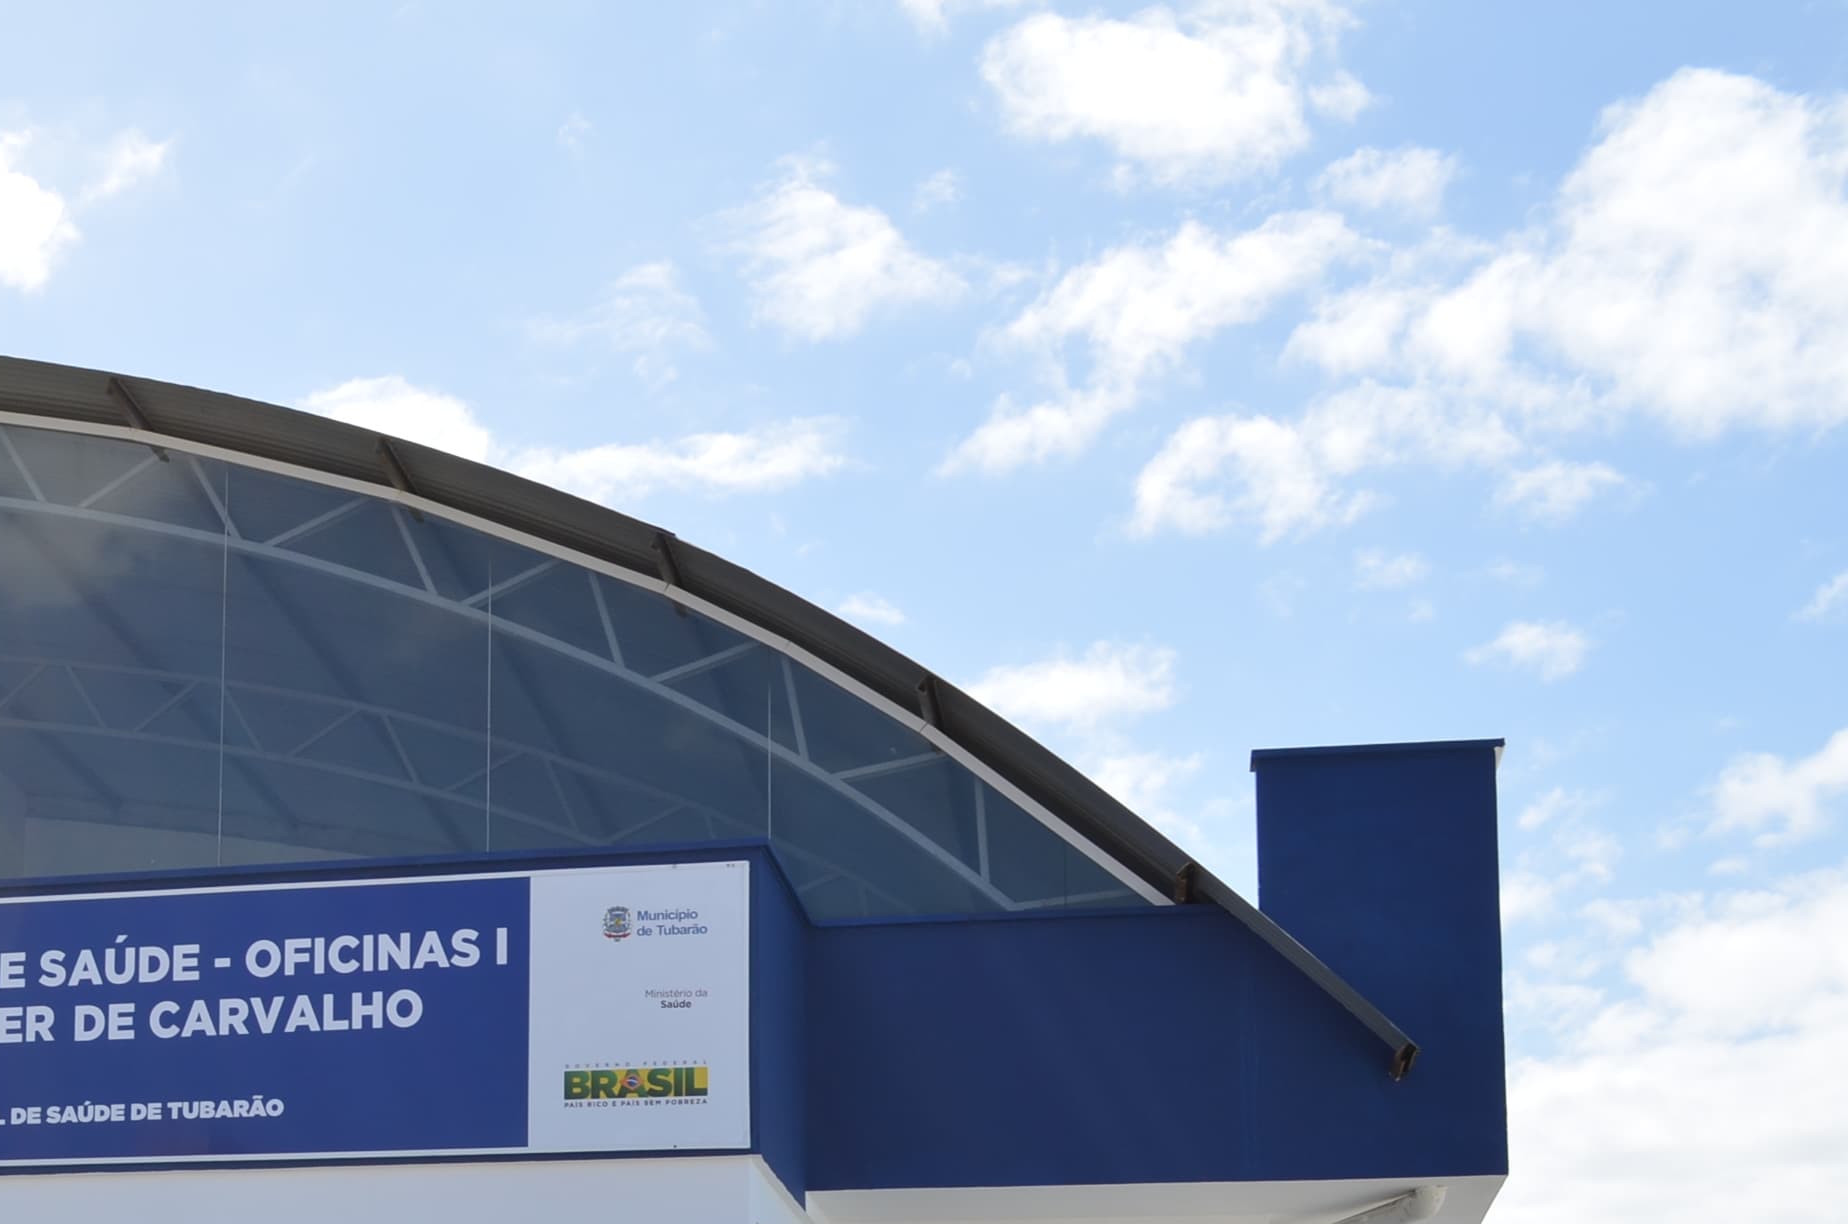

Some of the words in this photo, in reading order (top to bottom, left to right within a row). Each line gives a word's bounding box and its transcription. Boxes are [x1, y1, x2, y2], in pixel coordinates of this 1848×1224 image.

[636, 909, 699, 923] Município
[636, 926, 653, 937] de
[656, 924, 708, 937] Tubarão
[38, 934, 200, 987] SAÚDE
[214, 956, 232, 968] -
[245, 928, 481, 978] OFICINAS
[496, 927, 508, 965] I
[660, 999, 692, 1009] Saúde
[695, 988, 708, 998] da
[74, 1003, 135, 1042] DE
[149, 989, 424, 1039] CARVALHO
[564, 1067, 708, 1100] BRASIL
[10, 1107, 41, 1126] DE
[46, 1100, 125, 1124] SAÚDE
[130, 1101, 162, 1121] DE
[167, 1095, 285, 1119] TUBARÃO
